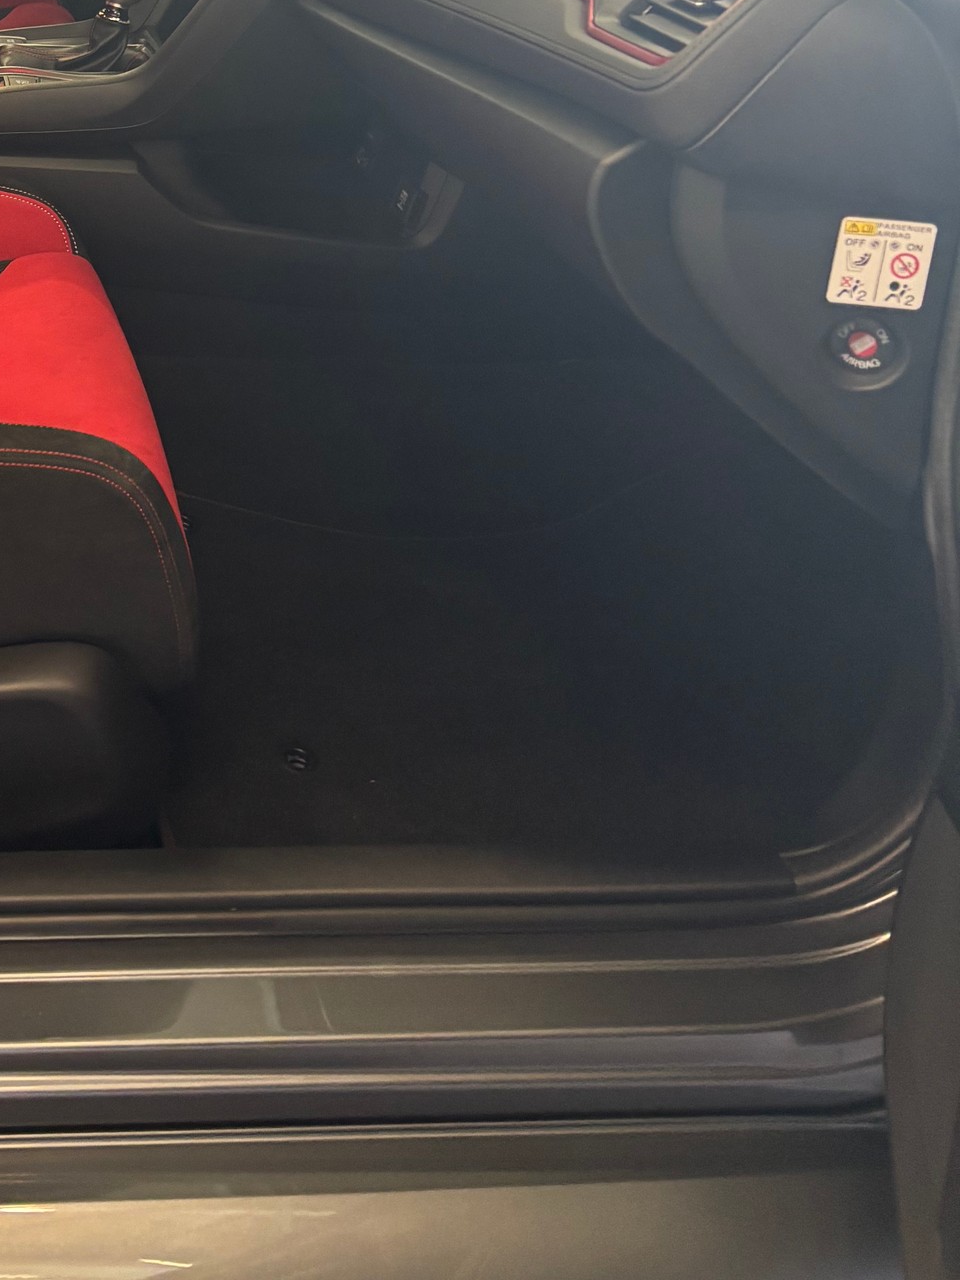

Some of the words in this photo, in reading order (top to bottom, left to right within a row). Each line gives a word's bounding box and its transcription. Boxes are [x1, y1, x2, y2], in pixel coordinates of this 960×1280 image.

[878, 223, 932, 233] PASSENGER
[878, 231, 911, 239] AIRBAG
[845, 238, 866, 246] OFF
[907, 243, 924, 252] ON
[876, 328, 890, 344] ON
[841, 353, 881, 369] AIRBAG
